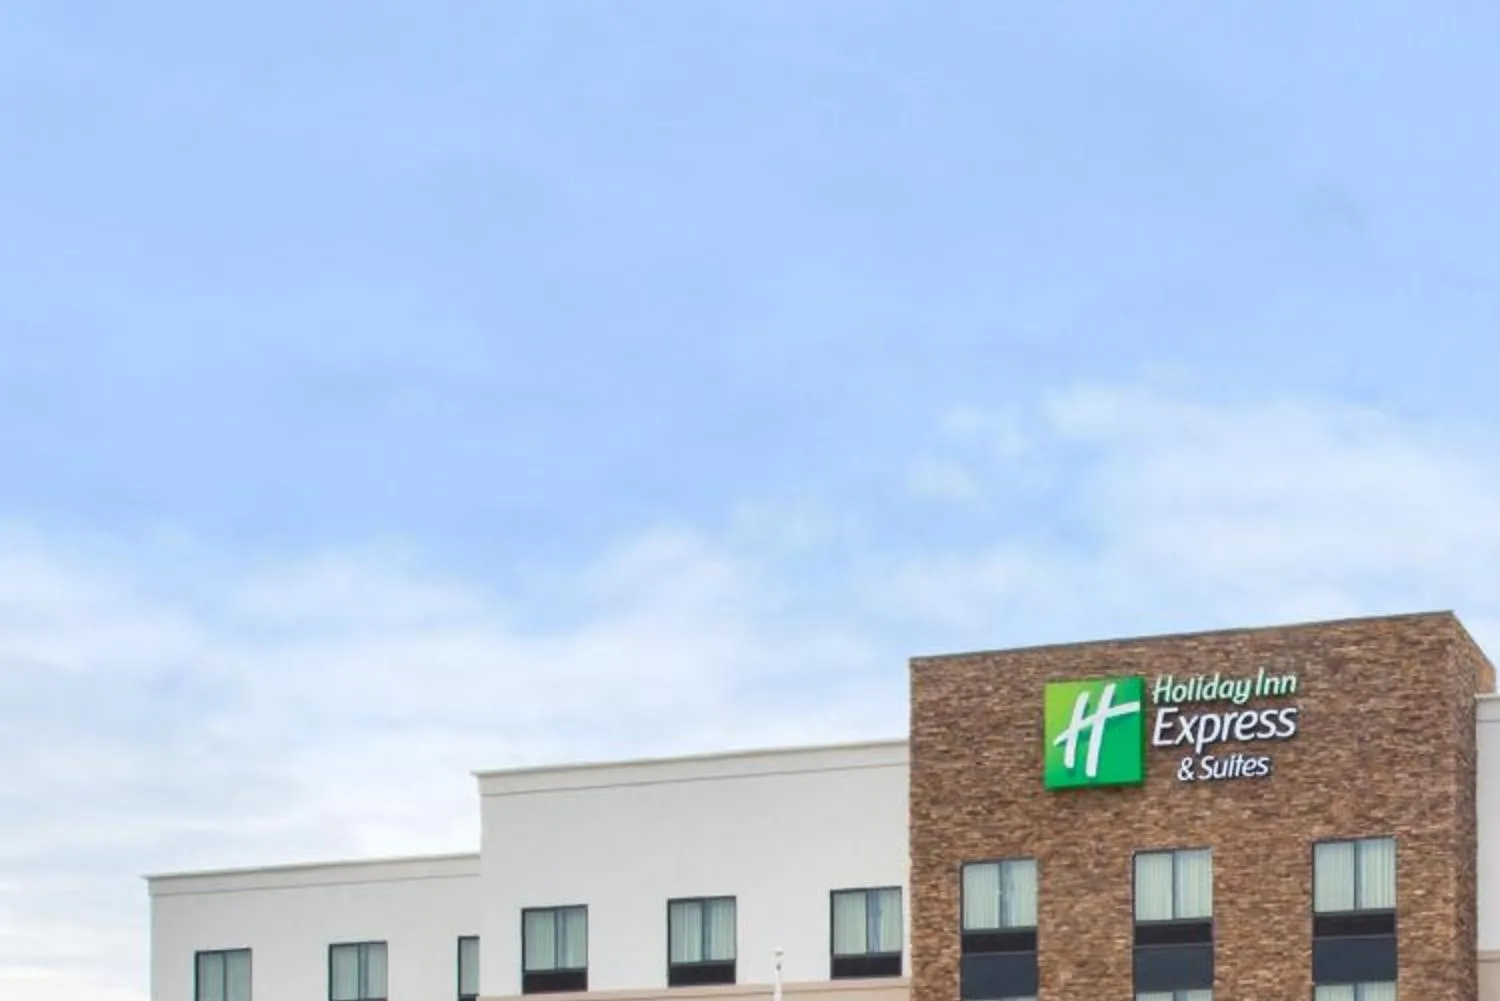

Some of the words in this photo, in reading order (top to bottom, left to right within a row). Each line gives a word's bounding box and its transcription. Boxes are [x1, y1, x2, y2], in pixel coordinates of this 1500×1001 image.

[1152, 674, 1250, 704] Holiday
[1255, 667, 1297, 695] Inn
[1151, 706, 1298, 753] Express
[1177, 756, 1194, 781] &
[1200, 754, 1270, 780] Suites
